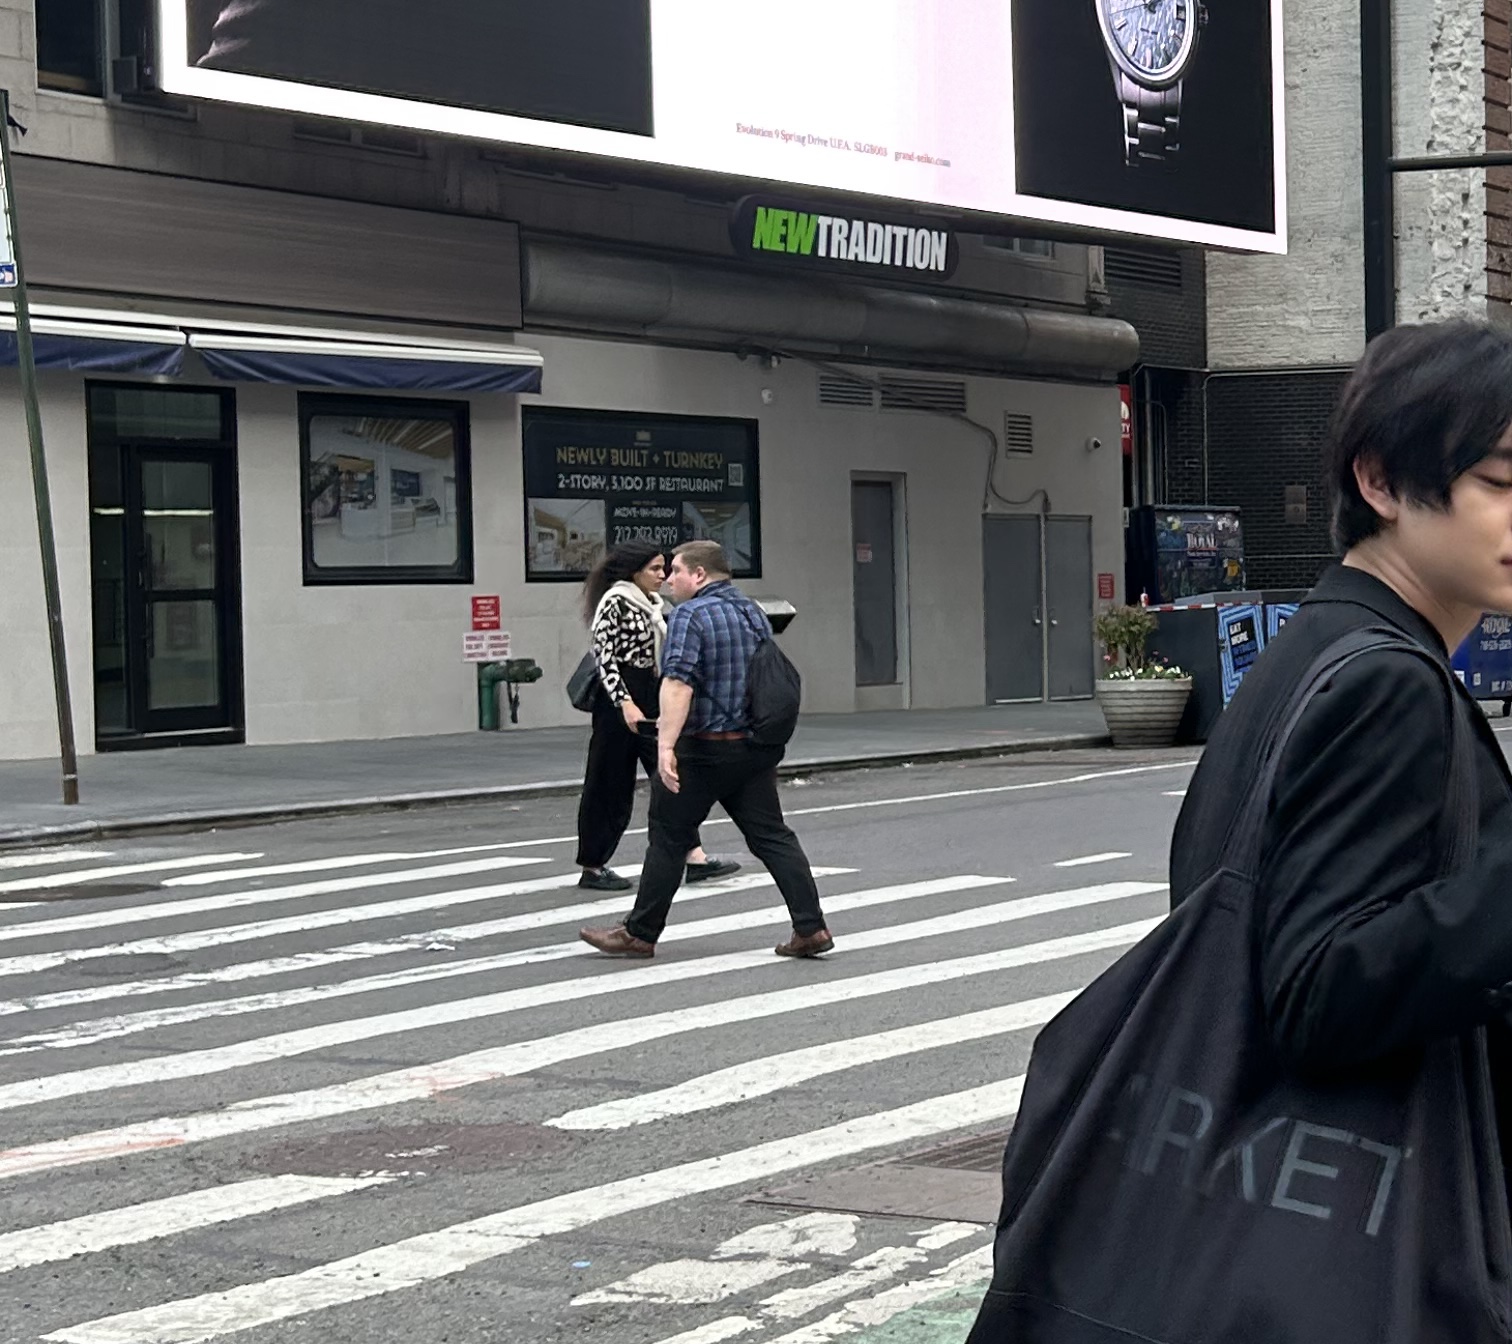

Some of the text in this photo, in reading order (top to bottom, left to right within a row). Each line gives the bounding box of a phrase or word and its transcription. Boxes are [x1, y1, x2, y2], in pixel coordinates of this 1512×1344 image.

[736, 123, 774, 139] Evolution
[781, 130, 806, 147] Spring
[807, 134, 828, 147] Drive
[556, 446, 607, 466] NEWLY
[611, 448, 648, 467] BUILT
[664, 450, 723, 469] TURNKEY
[557, 473, 610, 492] 2-STORY,
[659, 477, 724, 493] RESTAURANT
[1120, 1076, 1412, 1238] RKET
